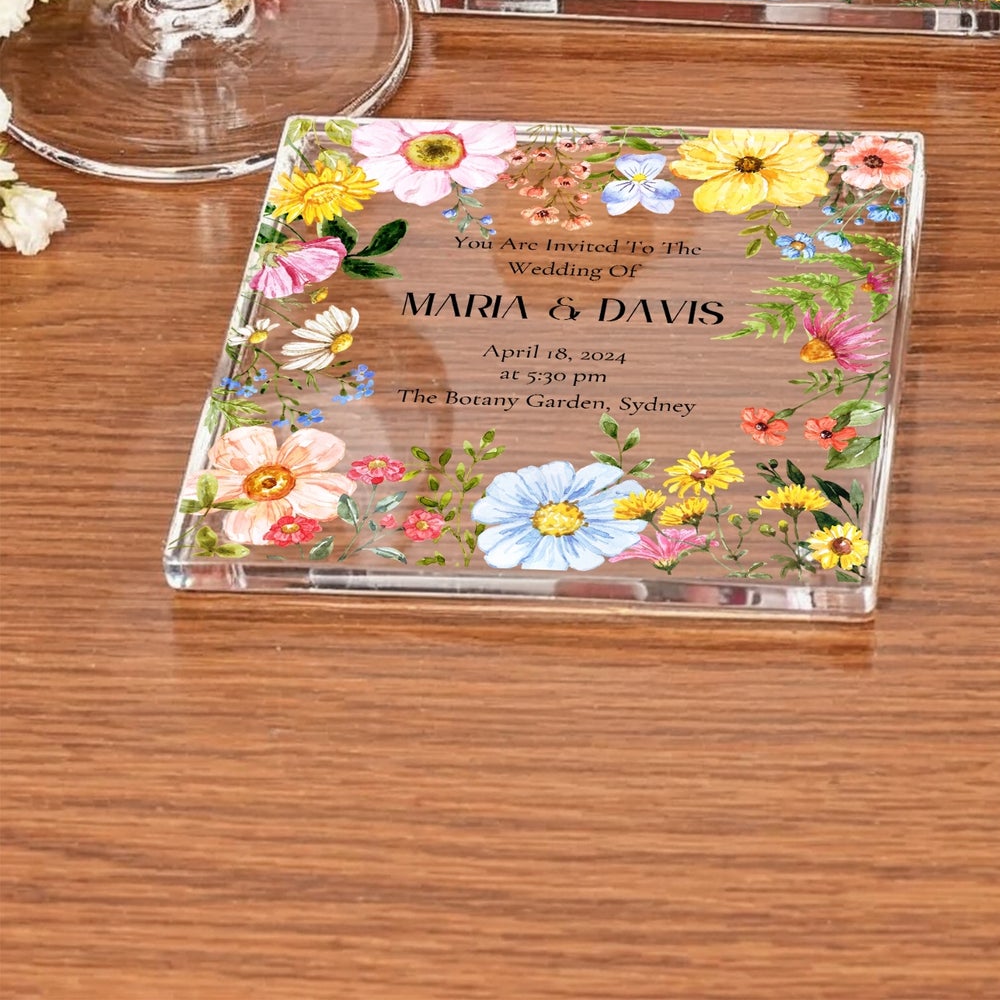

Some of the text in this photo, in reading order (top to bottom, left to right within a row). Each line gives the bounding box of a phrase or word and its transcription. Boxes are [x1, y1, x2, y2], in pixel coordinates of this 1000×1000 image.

[454, 236, 701, 256] You Are Invited To The
[507, 261, 642, 281] Wedding Of
[401, 292, 725, 325] MARIA & DAVIS
[482, 344, 627, 365] April 18, 2024
[499, 369, 607, 387] at 5:30 pm
[397, 388, 696, 417] The Botany Garden, Sydney
